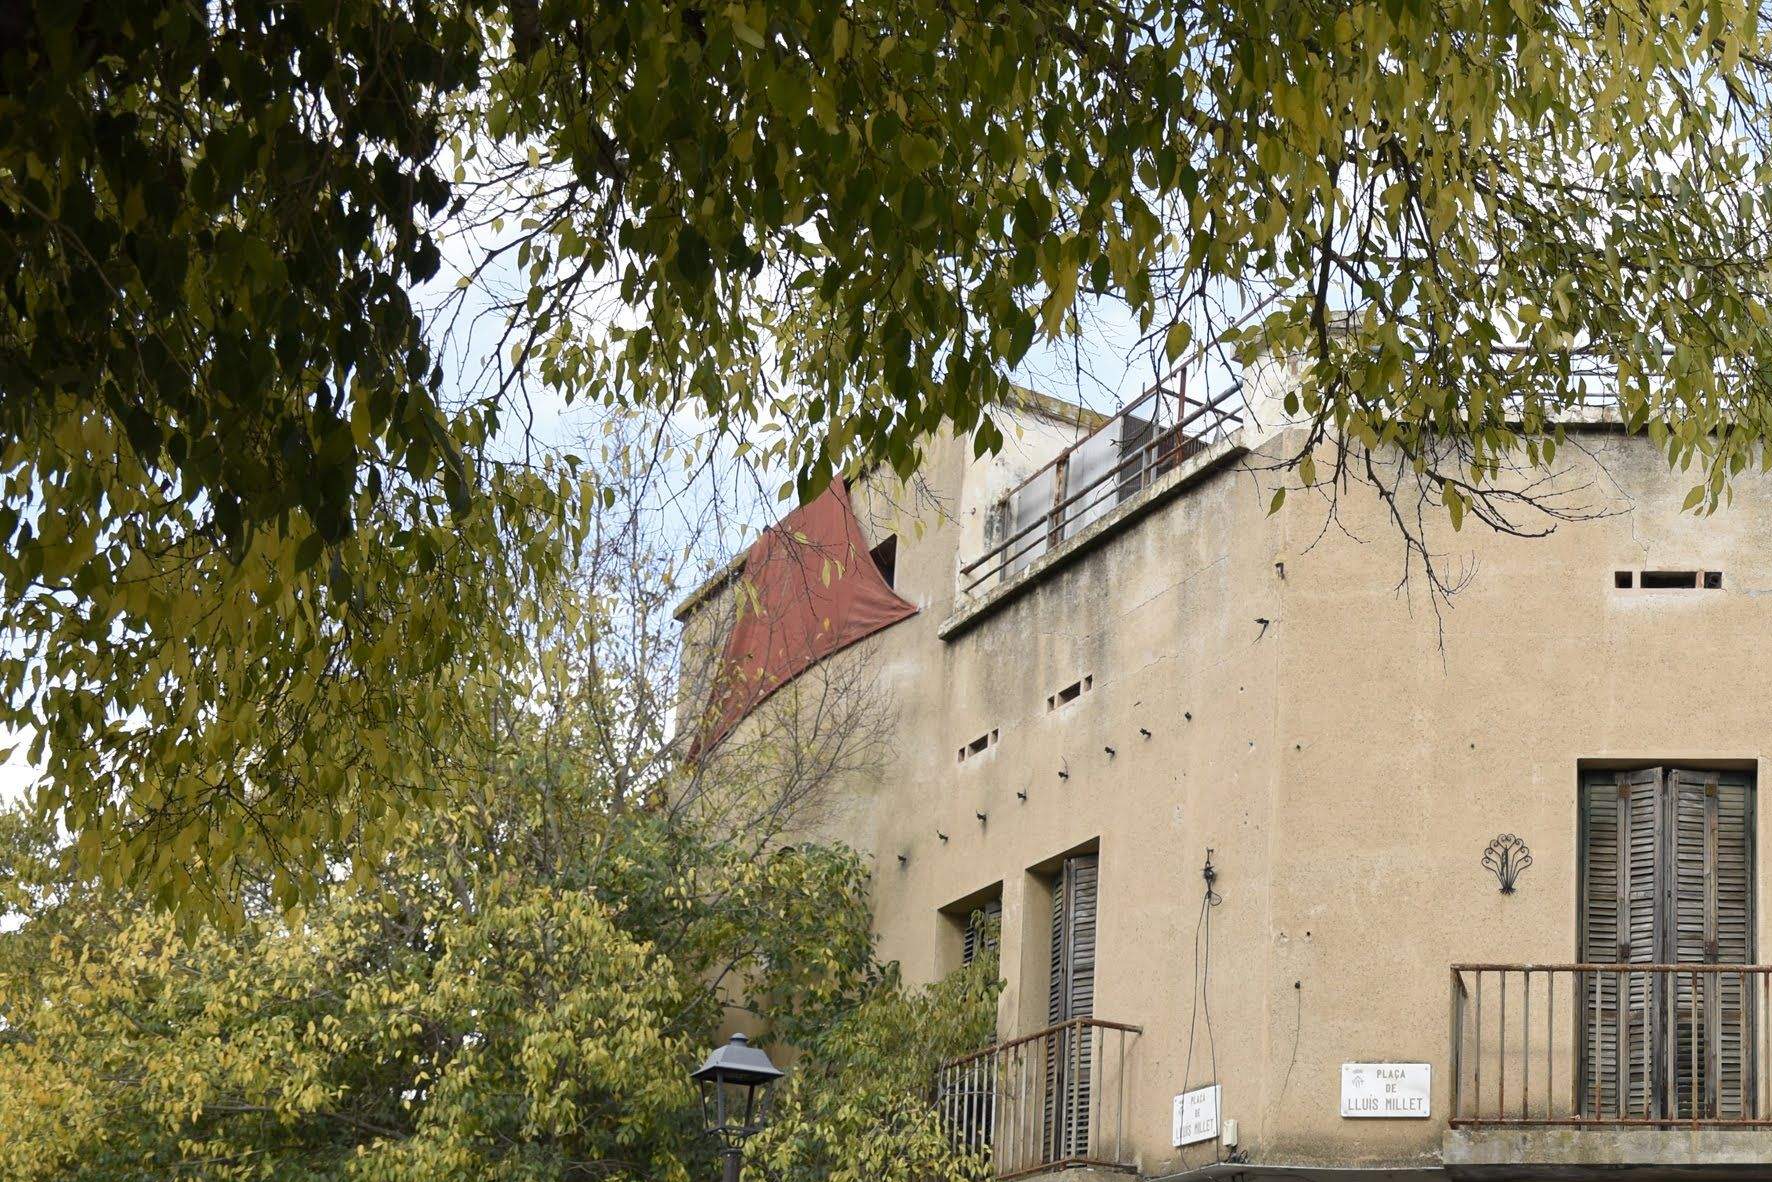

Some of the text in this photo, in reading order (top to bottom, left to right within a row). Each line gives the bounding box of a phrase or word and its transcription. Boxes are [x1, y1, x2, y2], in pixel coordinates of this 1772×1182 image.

[1376, 1069, 1406, 1080] PLAÇA
[1385, 1084, 1397, 1093] DE
[1385, 1098, 1423, 1111] MILLET
